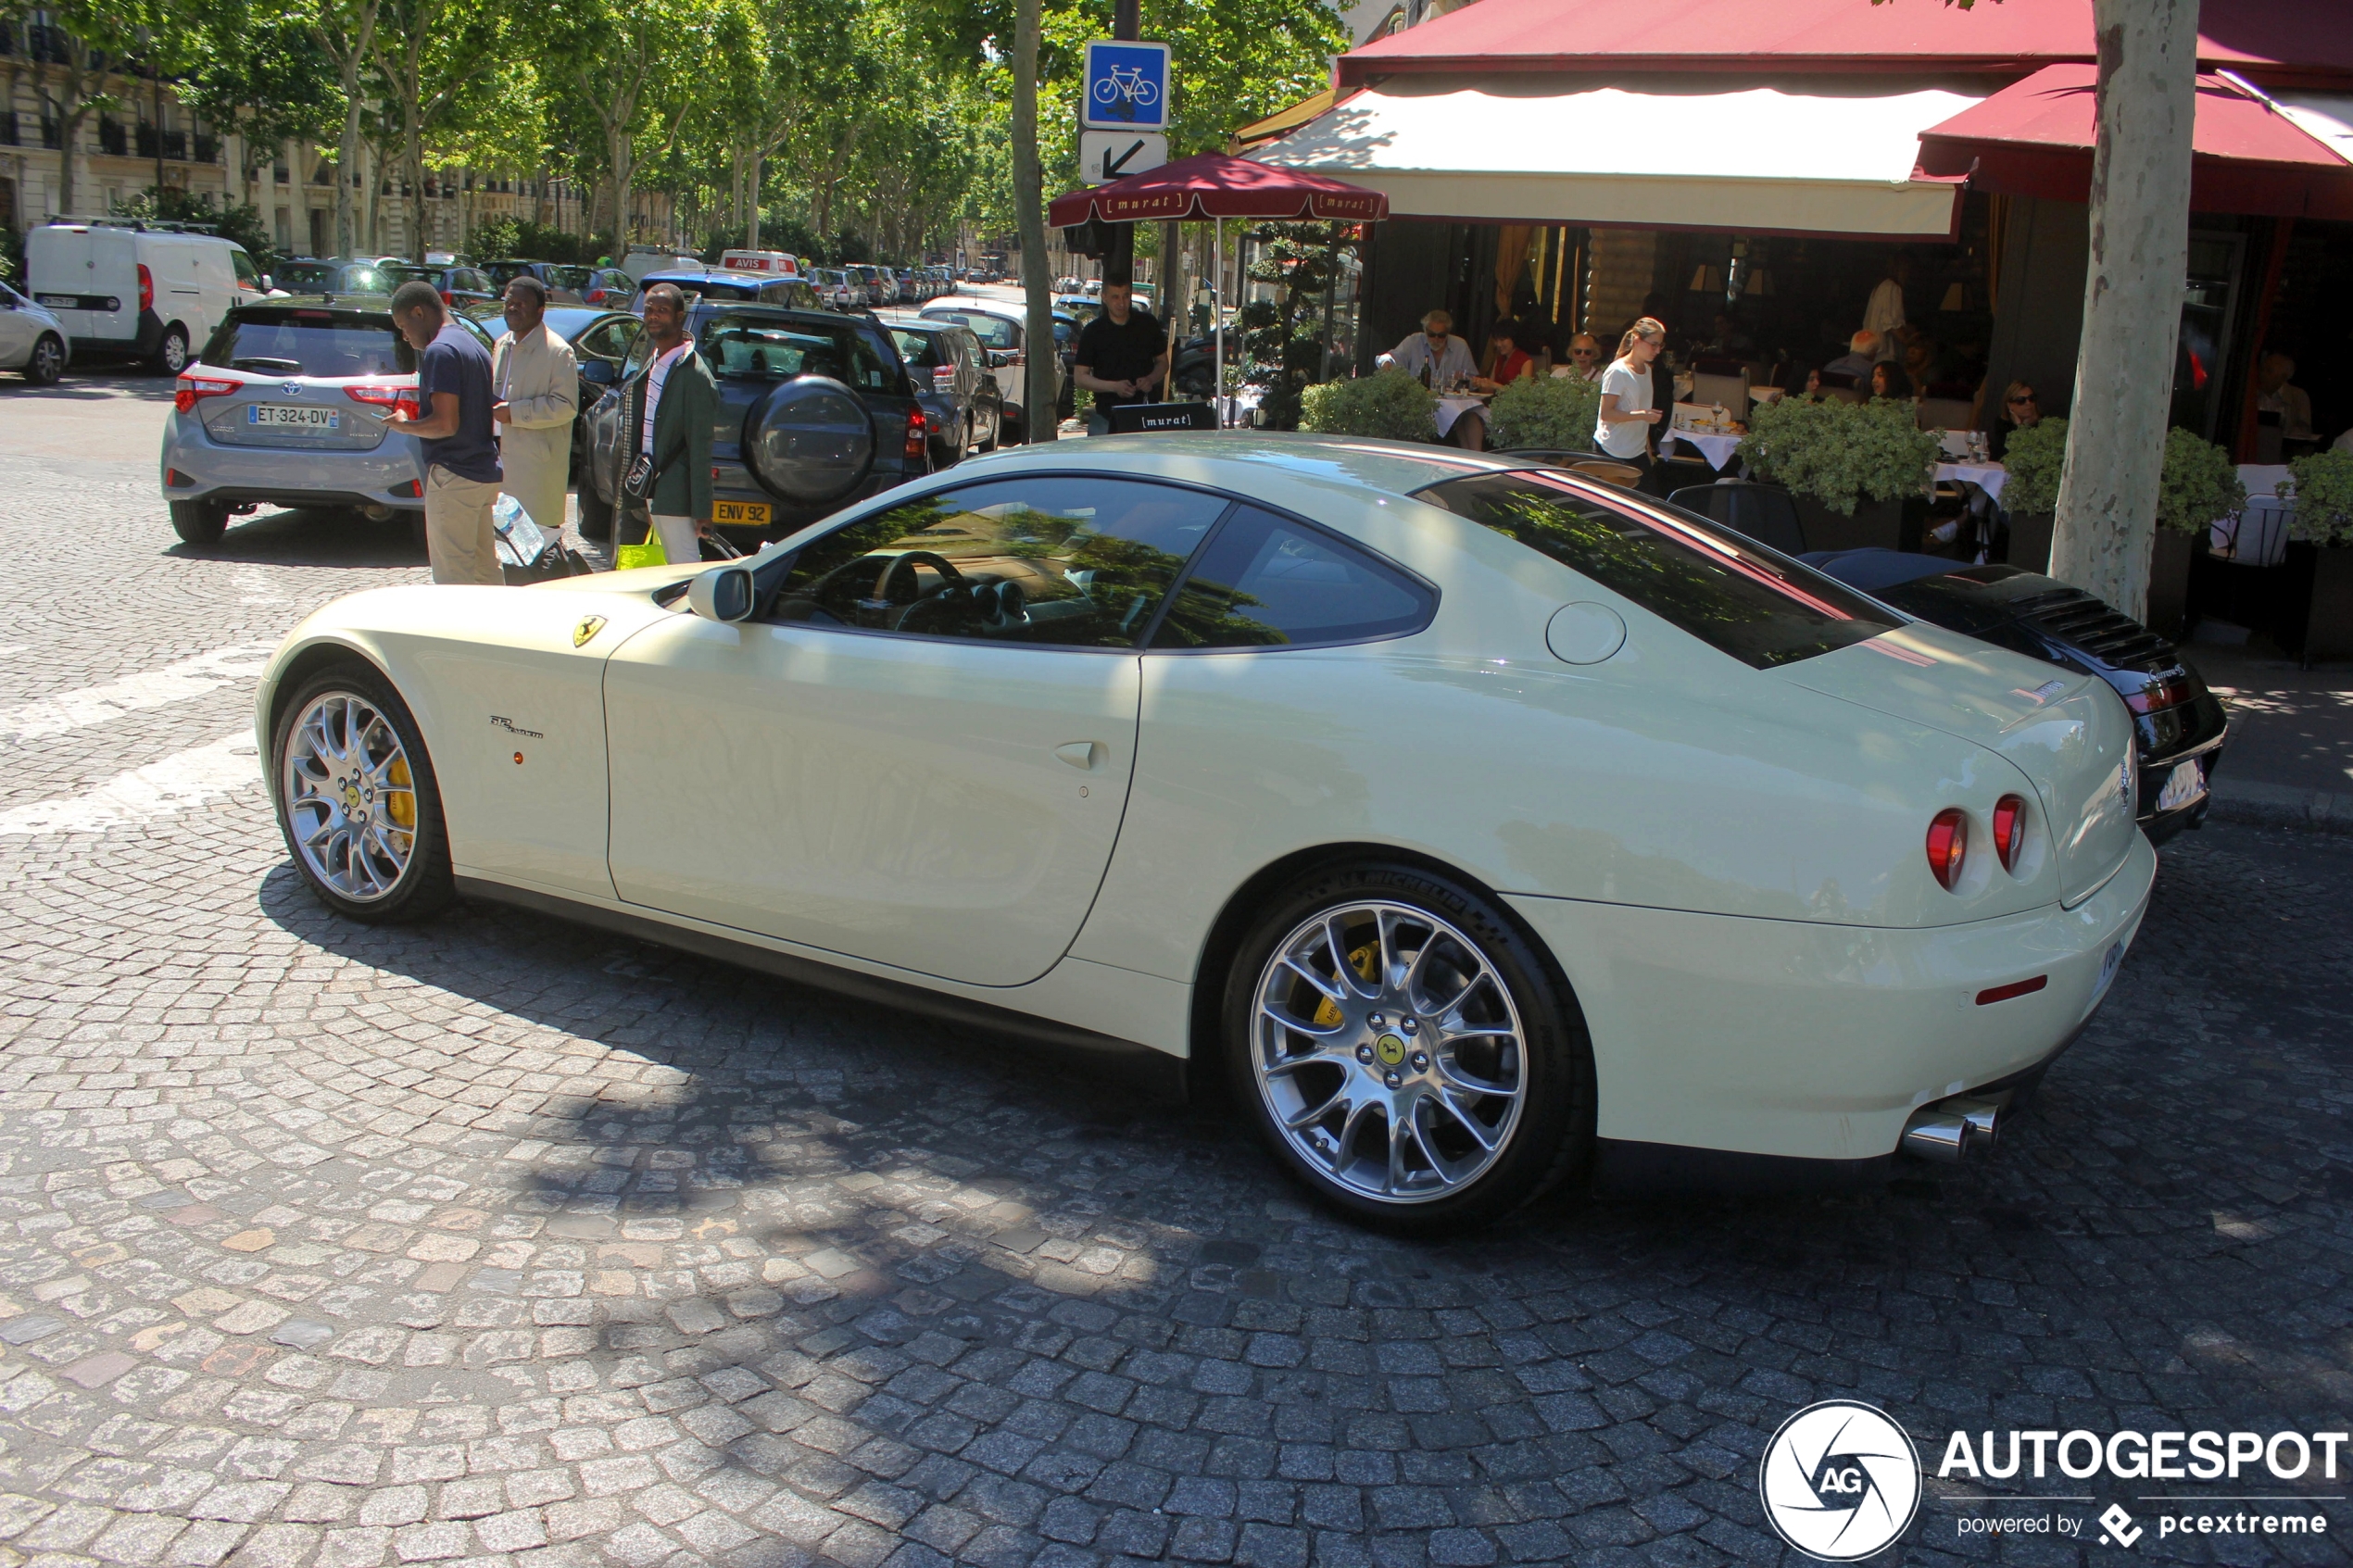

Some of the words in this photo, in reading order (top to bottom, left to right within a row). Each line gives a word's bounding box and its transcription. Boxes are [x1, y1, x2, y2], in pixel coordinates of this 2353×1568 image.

[735, 258, 760, 269] AVIS
[258, 408, 329, 424] ET-324-DV
[719, 504, 744, 520] ENV
[748, 506, 765, 521] 92
[1364, 871, 1468, 914] MICHELIN
